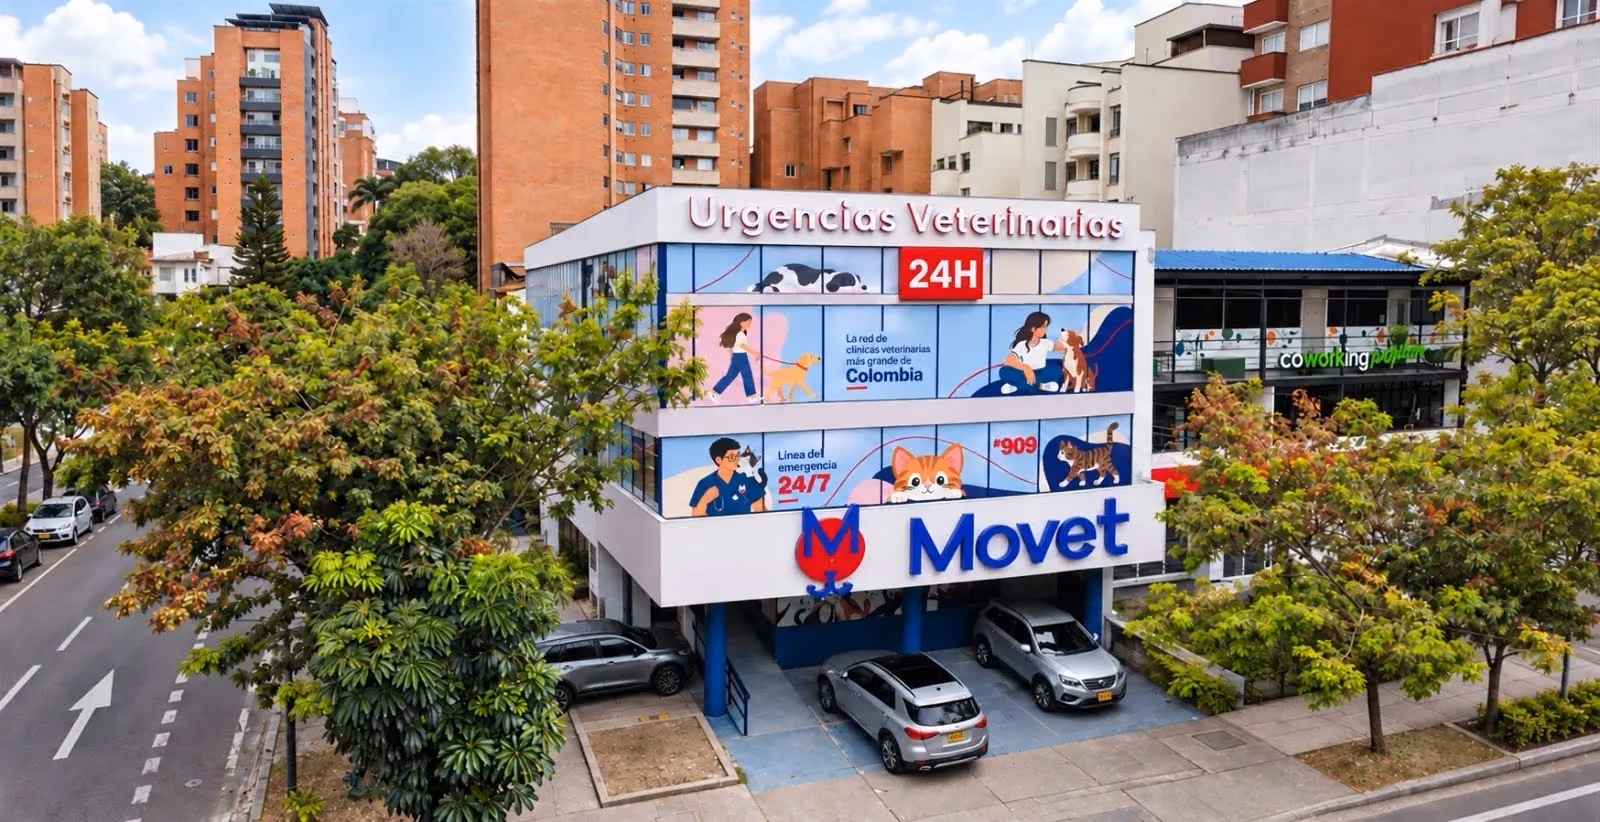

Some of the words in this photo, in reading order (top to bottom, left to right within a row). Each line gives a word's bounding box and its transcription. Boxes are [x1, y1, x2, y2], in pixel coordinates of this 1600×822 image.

[688, 196, 897, 237] Urgencias
[906, 202, 1125, 239] Veterinarias
[909, 259, 978, 289] 24H
[846, 334, 857, 343] La
[859, 334, 874, 343] red
[875, 334, 888, 343] de
[881, 344, 931, 354] veterinarias
[867, 356, 898, 367] grande
[900, 356, 912, 365] de
[1280, 347, 1370, 371] coworking
[846, 367, 923, 383] Colombia
[778, 450, 805, 460] Línea
[778, 460, 837, 473] emergencia
[778, 473, 831, 495] 24/7
[909, 497, 1130, 576] Movet
